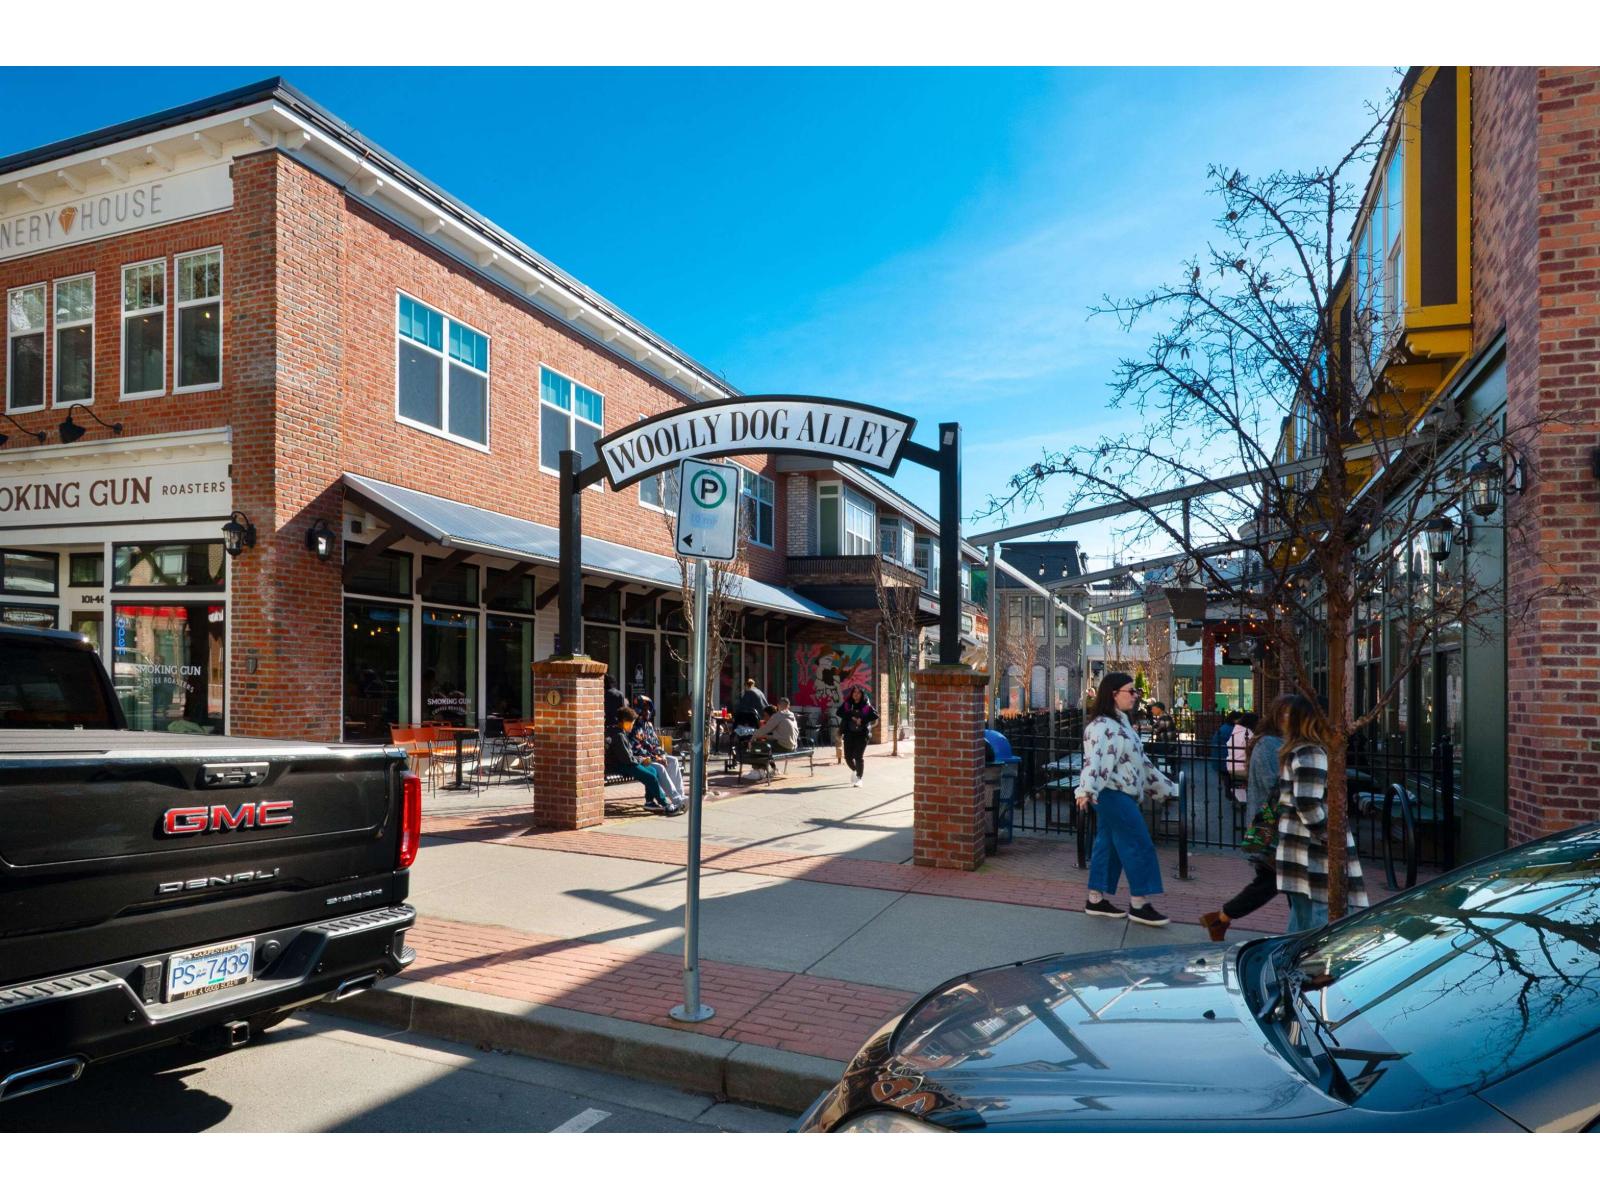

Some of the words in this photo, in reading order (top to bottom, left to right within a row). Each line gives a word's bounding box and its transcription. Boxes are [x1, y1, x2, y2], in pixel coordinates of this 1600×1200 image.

[81, 184, 163, 231] HOUSE
[606, 412, 724, 475] WOOLLY
[730, 408, 789, 442] DOG
[796, 410, 901, 466] ALLEY
[89, 476, 152, 506] GUN
[162, 481, 226, 496] ROASTERS
[700, 478, 719, 500] P
[134, 664, 177, 675] SMOKING
[180, 665, 201, 675] GUN
[163, 800, 293, 835] GMC
[158, 867, 280, 894] DENALI
